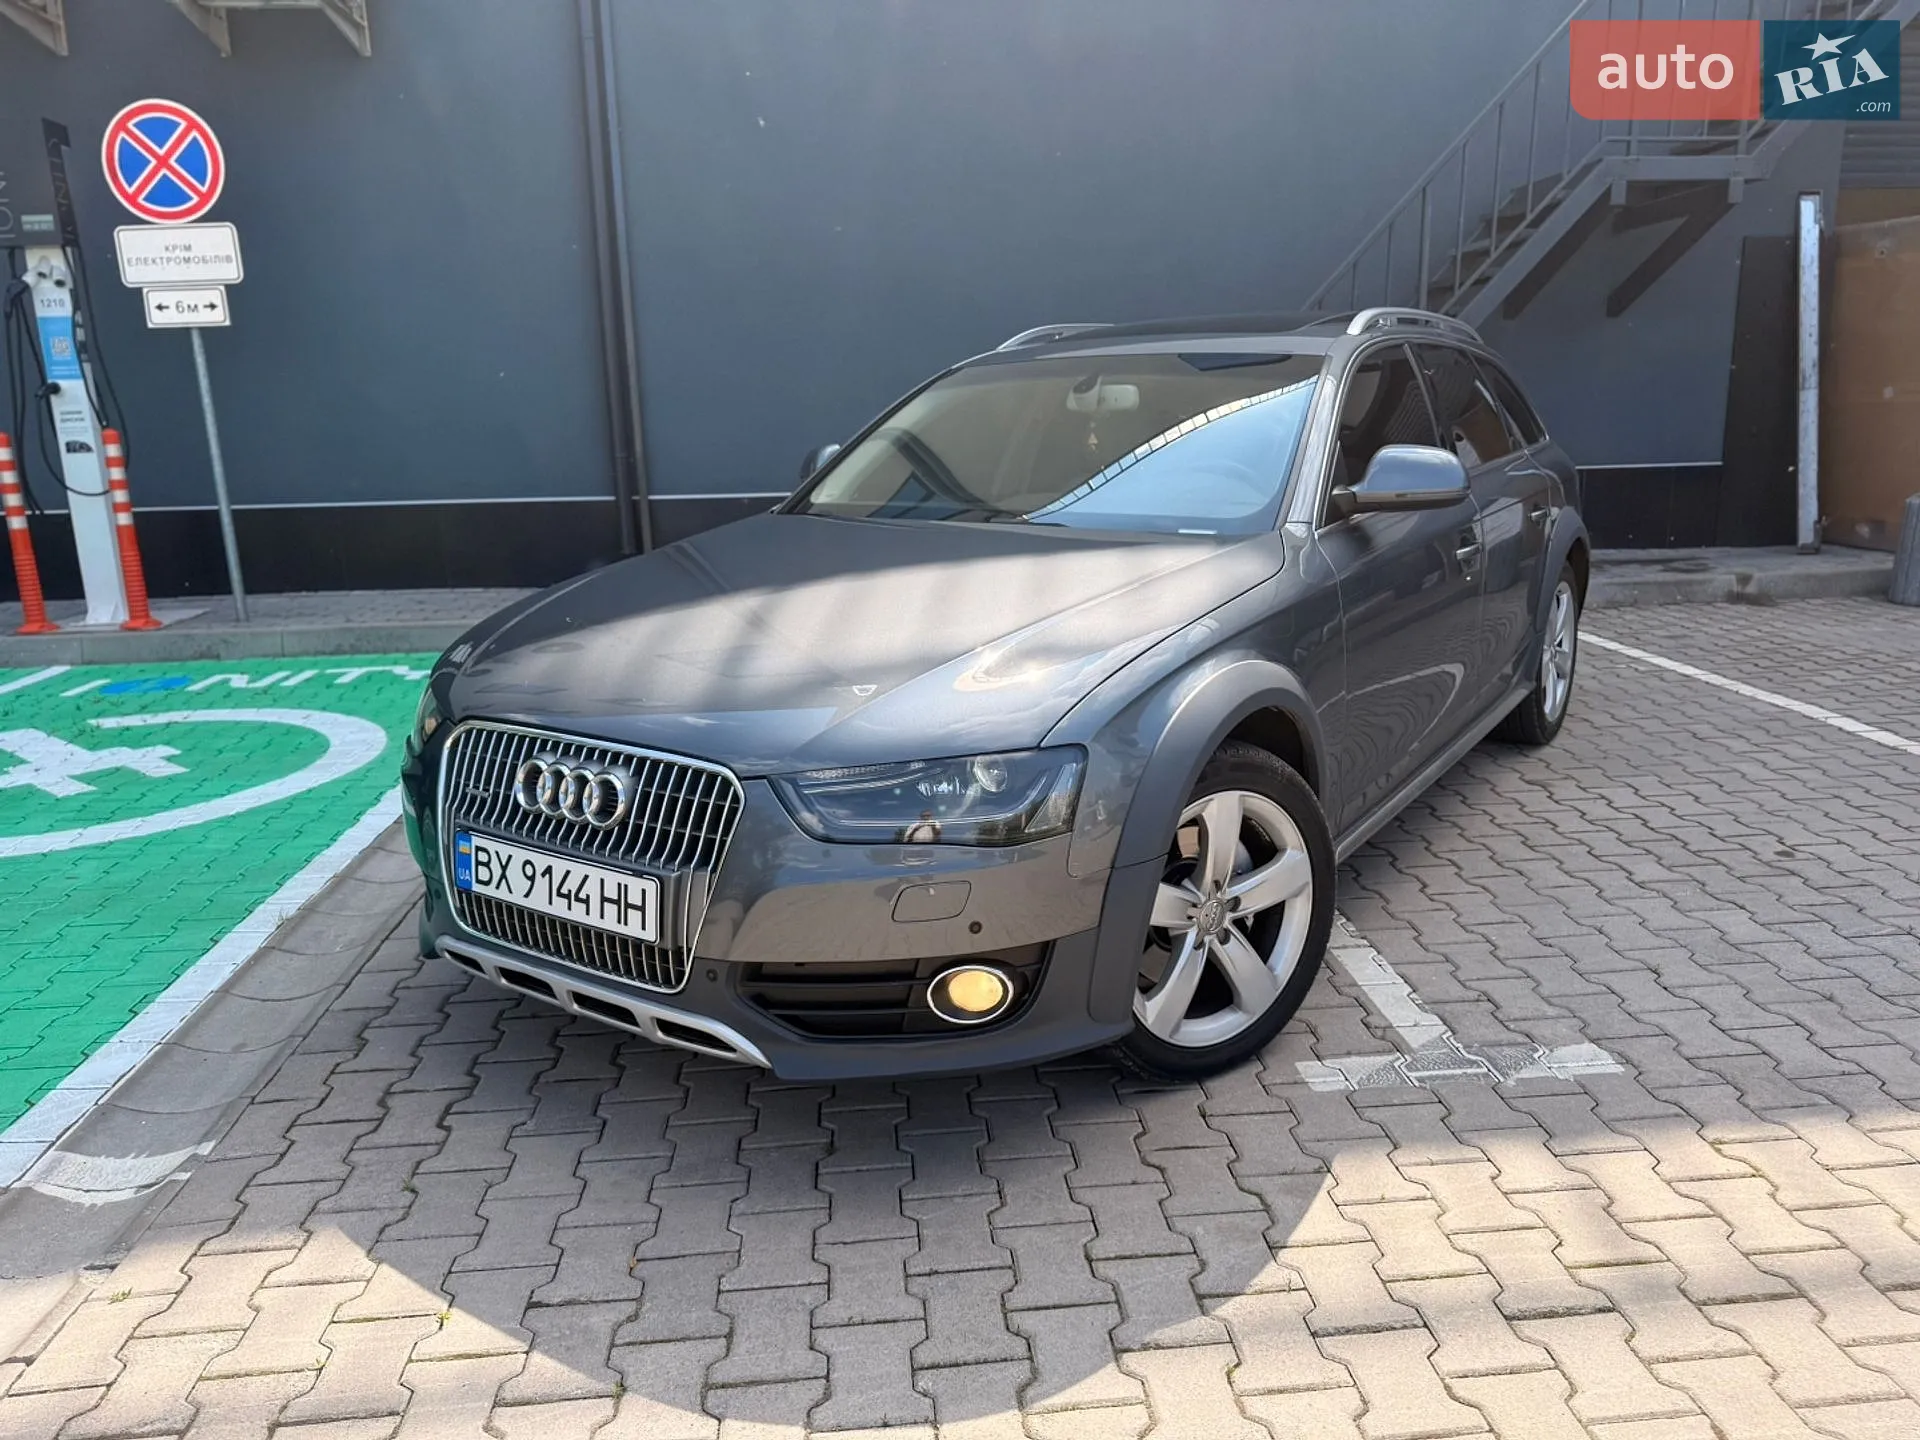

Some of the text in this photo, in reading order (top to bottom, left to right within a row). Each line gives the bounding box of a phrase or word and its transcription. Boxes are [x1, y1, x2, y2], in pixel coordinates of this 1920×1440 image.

[164, 243, 193, 253] КРІМ
[127, 254, 234, 267] ЕЛЕКТРОМОБІЛІВ
[40, 297, 66, 308] 1210
[458, 865, 472, 882] UA
[474, 846, 647, 932] BX 9144 HH
